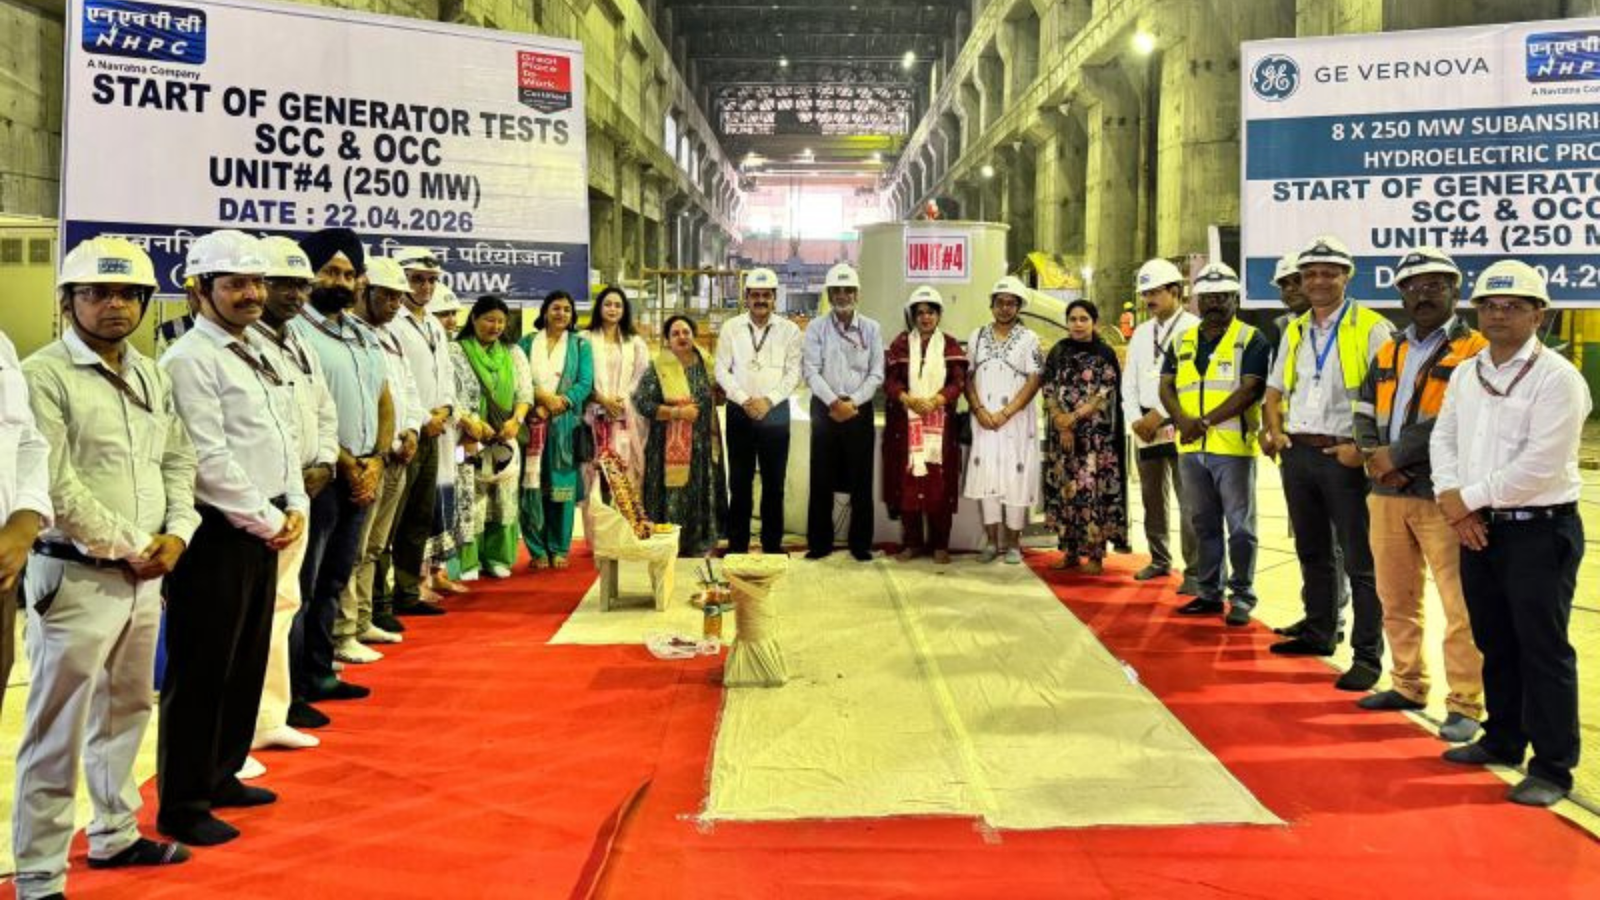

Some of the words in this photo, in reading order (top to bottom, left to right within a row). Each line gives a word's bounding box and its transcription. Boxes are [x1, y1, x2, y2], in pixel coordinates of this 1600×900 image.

[96, 27, 188, 55] NHPC
[87, 59, 96, 68] A
[98, 60, 148, 75] Navratna
[150, 65, 201, 81] Company
[521, 53, 557, 65] Great
[1315, 66, 1349, 83] GE
[1358, 57, 1490, 81] VERNOVA
[92, 73, 211, 113] START
[223, 86, 267, 118] OF
[278, 91, 471, 137] GENERATOR
[479, 111, 570, 146] TESTS
[1331, 122, 1345, 141] 8
[1350, 121, 1365, 139] X
[1371, 120, 1411, 139] 250
[1417, 117, 1465, 137] MW
[255, 123, 324, 158] SCC
[337, 130, 361, 160] &
[373, 132, 442, 166] OCC
[1364, 144, 1549, 169] HYDROELECTRIC
[209, 155, 332, 193] UNIT#4
[343, 165, 409, 202] (250
[420, 171, 481, 209] MW)
[1273, 178, 1370, 201] START
[1381, 177, 1423, 198] OF
[218, 198, 297, 225] DATE
[306, 207, 314, 225] :
[324, 203, 474, 233] 22.04.2026
[1412, 200, 1481, 223] SCC
[1494, 198, 1519, 220] &
[1371, 225, 1489, 249] UNIT#4
[1501, 225, 1572, 252] (250
[456, 241, 564, 267] परियोजना
[909, 243, 963, 271] UNIT#4
